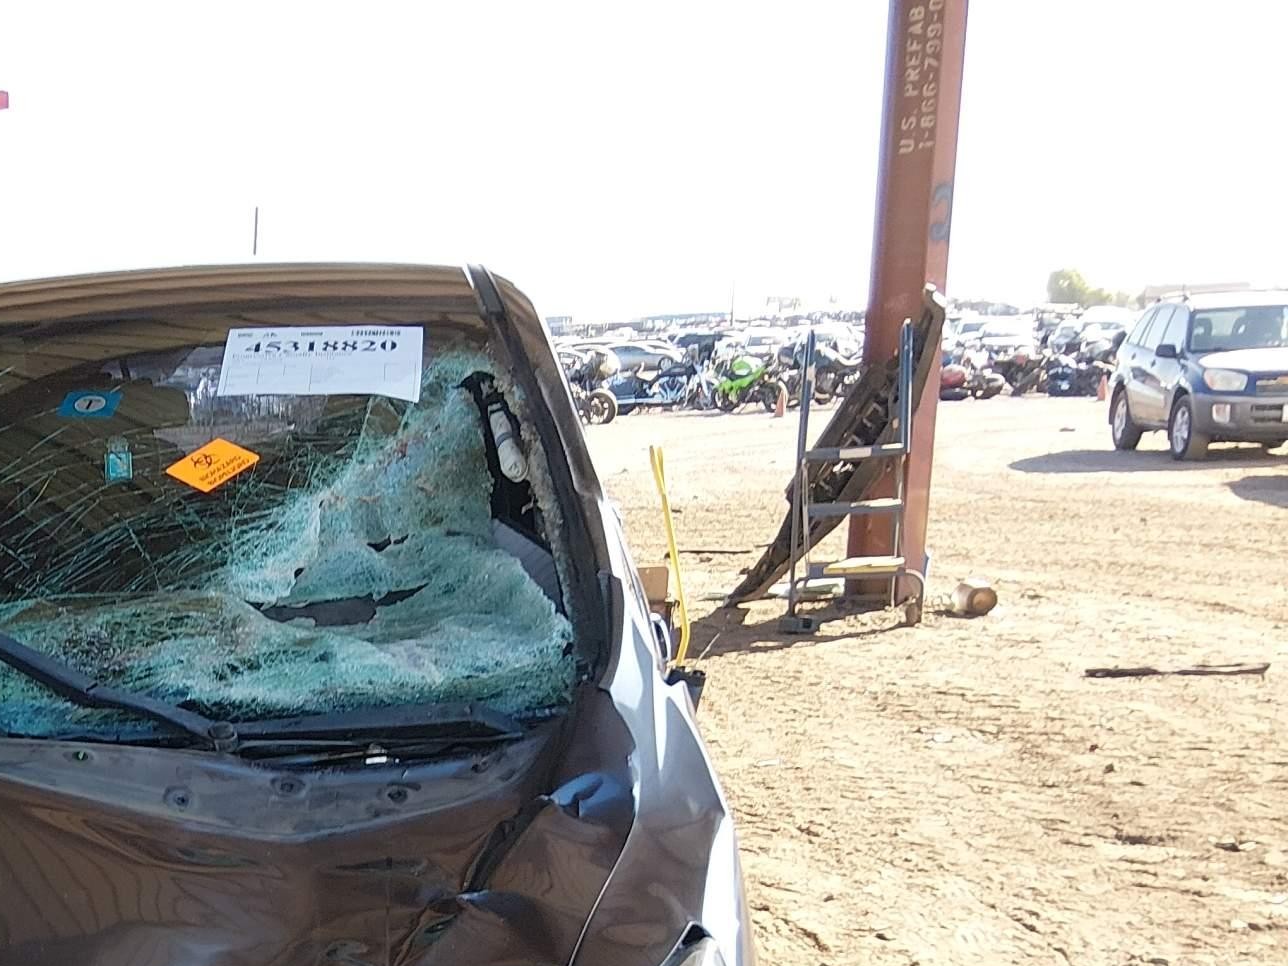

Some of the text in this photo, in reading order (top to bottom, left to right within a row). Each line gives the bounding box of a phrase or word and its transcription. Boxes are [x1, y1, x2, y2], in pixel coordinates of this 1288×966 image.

[898, 4, 925, 155] U.S. PREFAB
[244, 339, 398, 353] 45318820
